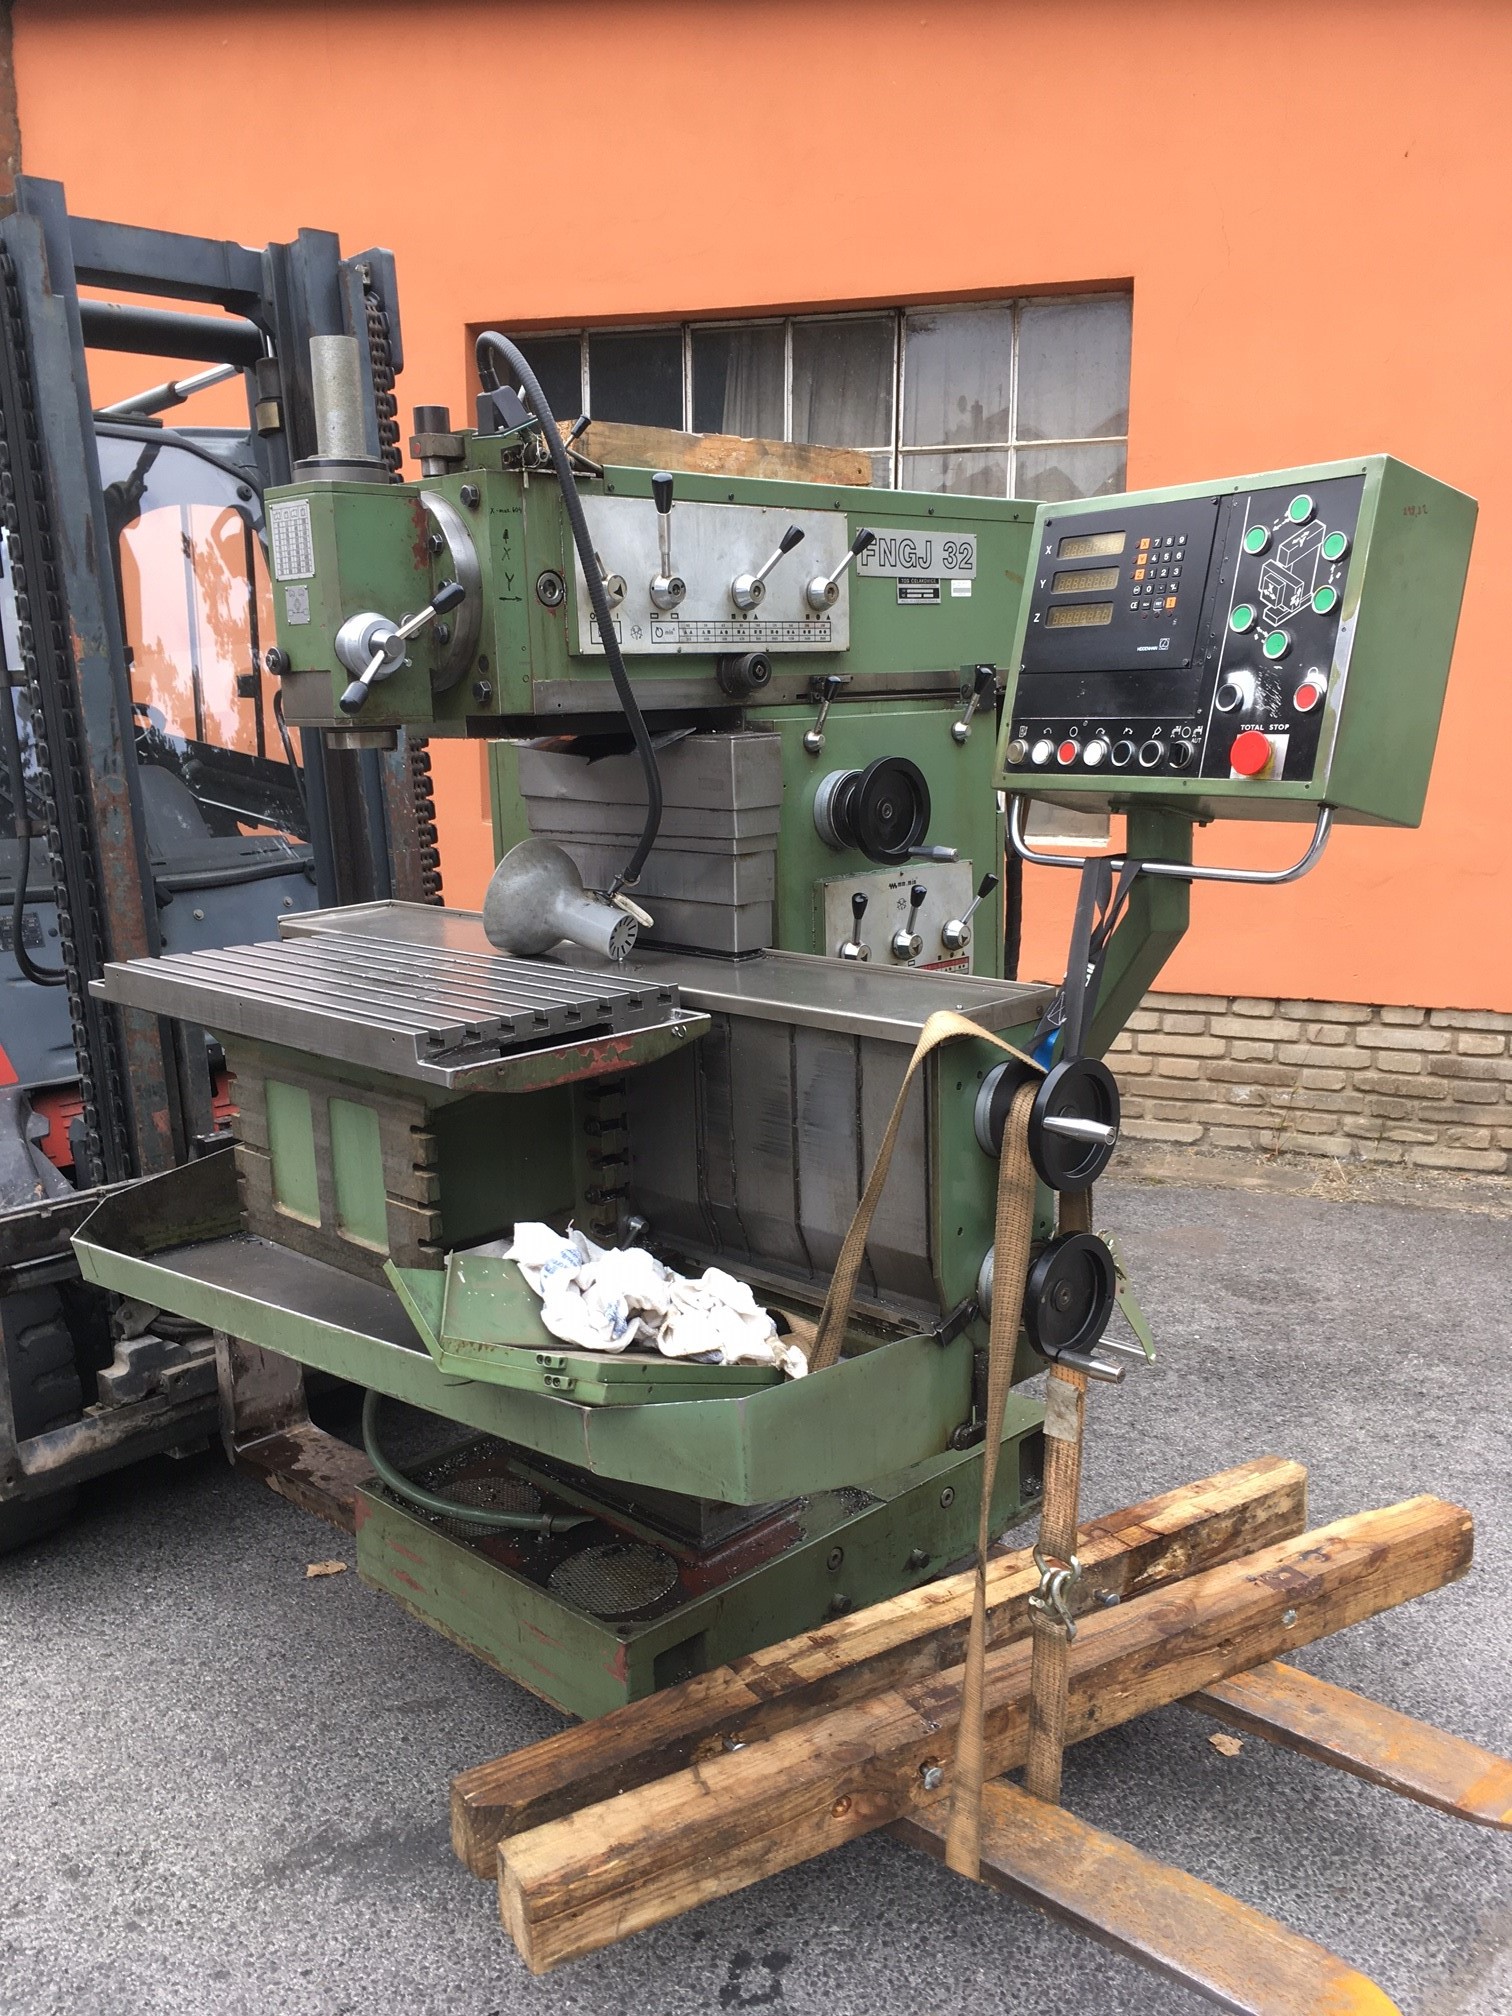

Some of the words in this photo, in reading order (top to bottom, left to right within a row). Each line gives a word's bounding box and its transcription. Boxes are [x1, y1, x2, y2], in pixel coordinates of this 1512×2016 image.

[1154, 539, 1160, 547] 7
[1166, 538, 1173, 546] 8
[1179, 536, 1185, 544] 9
[501, 547, 511, 561] X
[861, 538, 932, 570] FNGJ
[942, 541, 973, 570] 32
[1045, 545, 1052, 555] X
[1151, 554, 1157, 562] 4
[1161, 569, 1167, 577] 2
[504, 572, 514, 591] Y
[1040, 579, 1046, 588] Y
[1146, 585, 1152, 593] 0
[1130, 601, 1138, 609] CE
[1033, 613, 1040, 622] Z
[1269, 723, 1290, 731] STOP
